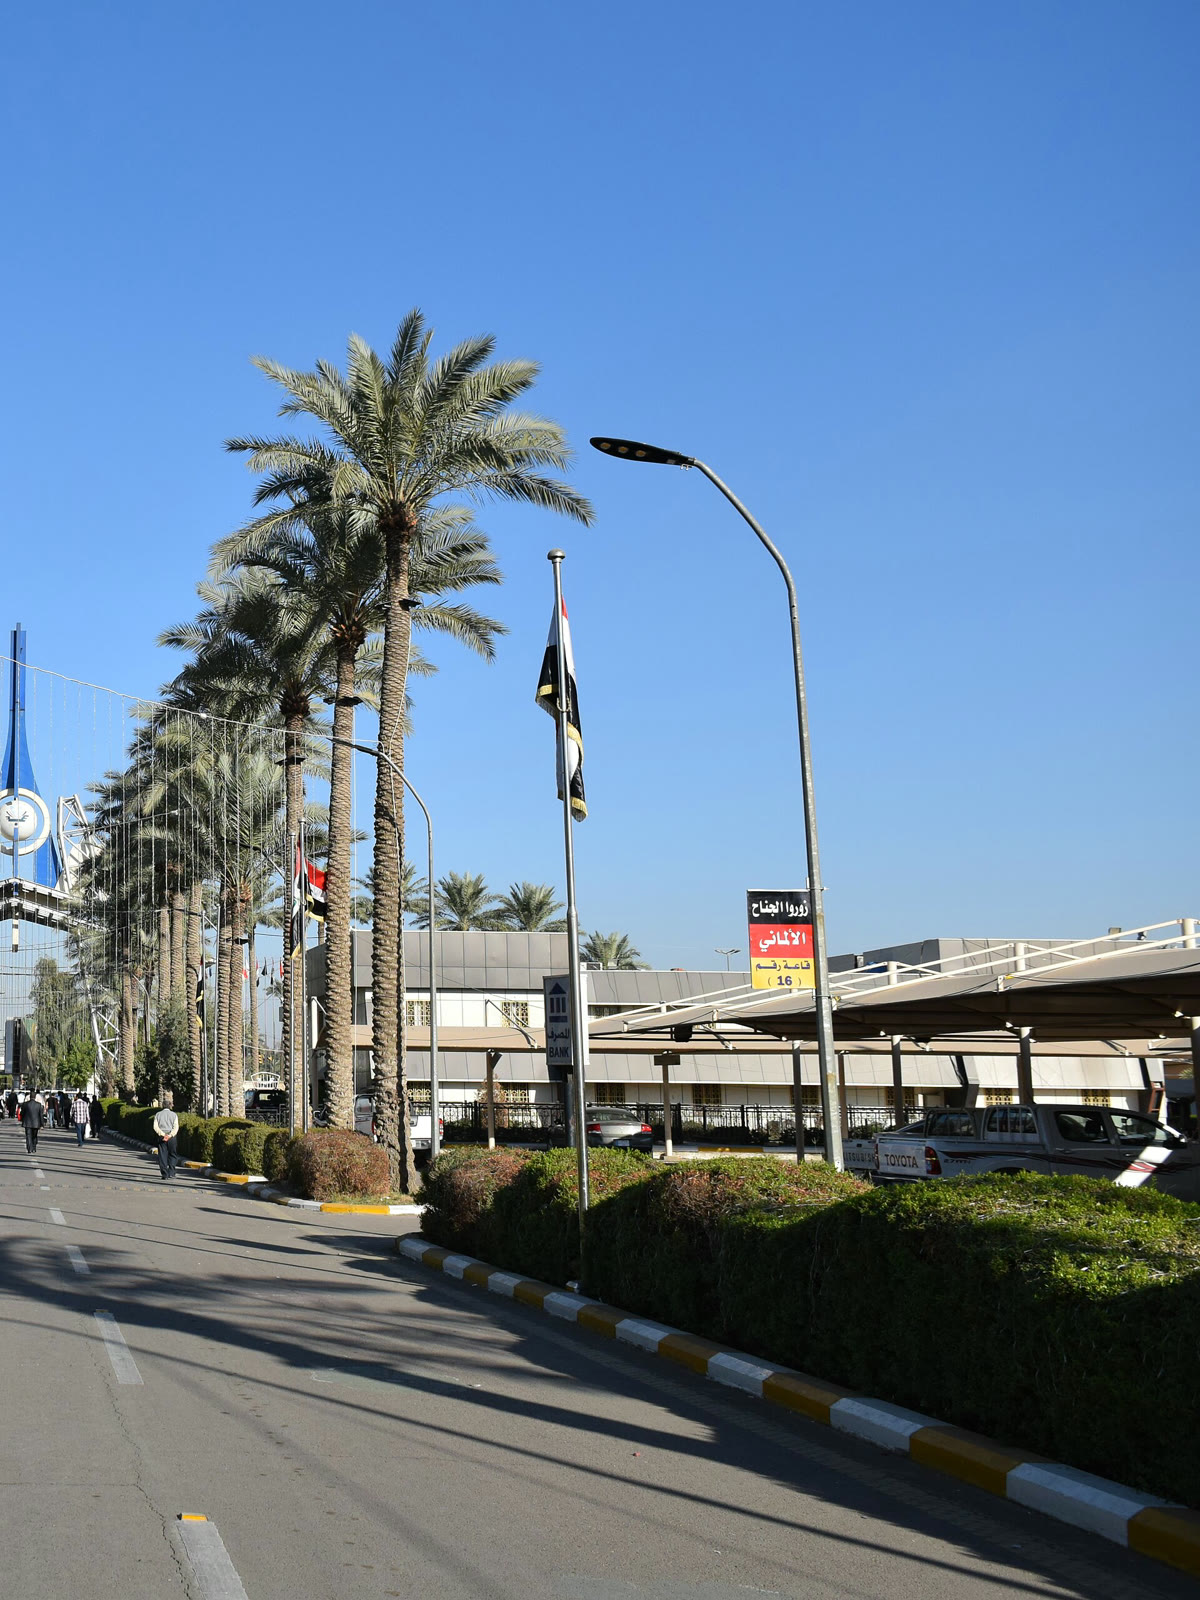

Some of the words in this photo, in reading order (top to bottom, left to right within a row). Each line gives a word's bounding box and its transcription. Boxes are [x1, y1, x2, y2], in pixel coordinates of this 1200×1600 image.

[751, 899, 784, 917] الجناح
[786, 899, 809, 917] زوروا
[759, 928, 806, 952] الألماني
[755, 960, 781, 972] رقم
[784, 960, 811, 970] قاعة
[777, 976, 793, 986] 16
[548, 1027, 570, 1042] المصرف
[549, 1046, 570, 1058] BANK
[843, 1152, 875, 1162] ITSUBISH
[884, 1153, 919, 1169] TOYOTA
